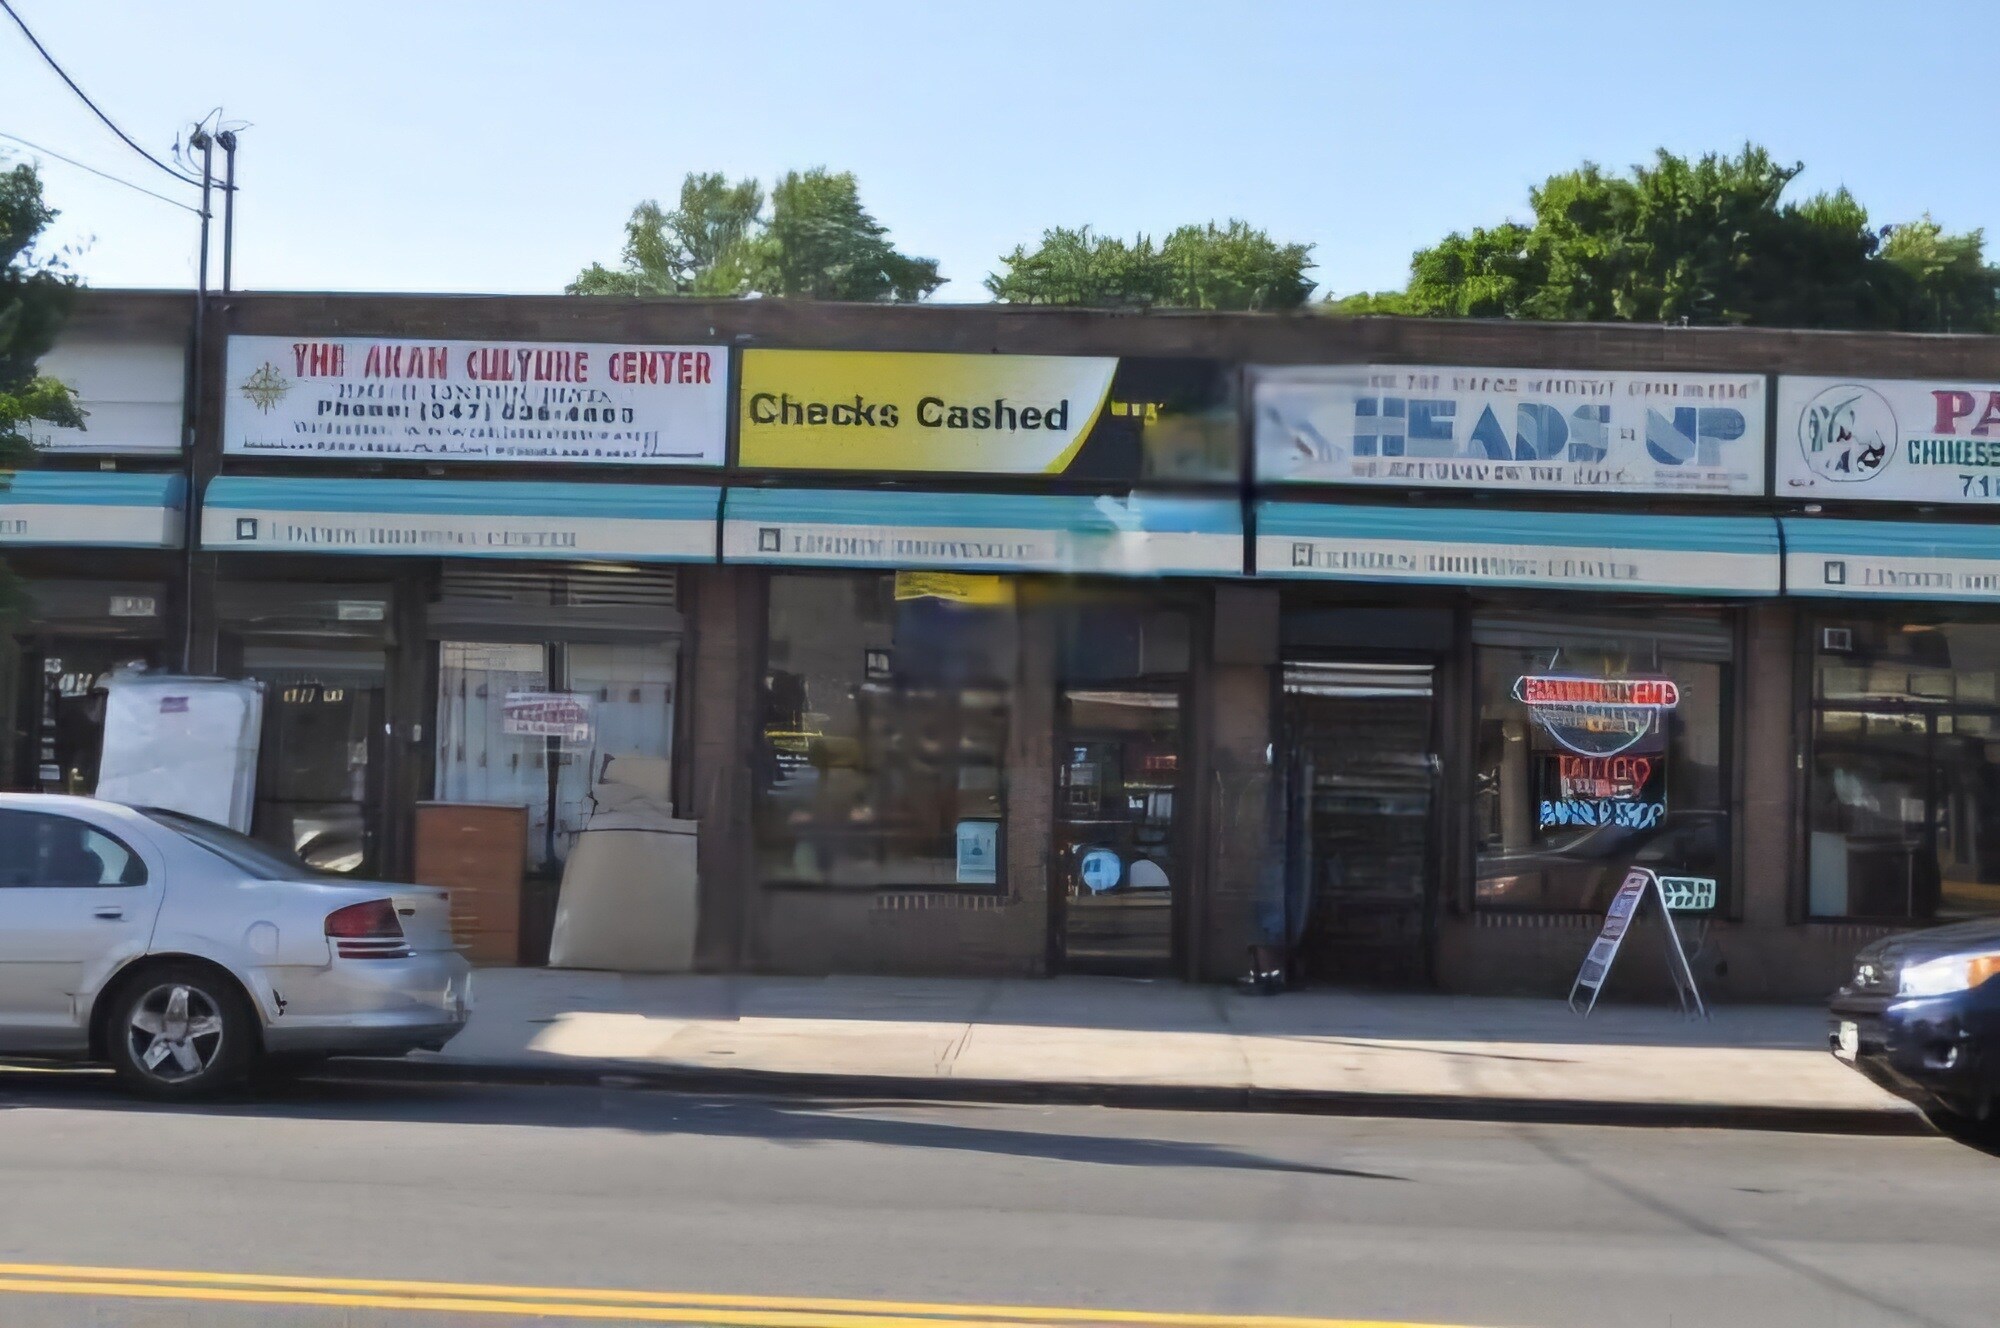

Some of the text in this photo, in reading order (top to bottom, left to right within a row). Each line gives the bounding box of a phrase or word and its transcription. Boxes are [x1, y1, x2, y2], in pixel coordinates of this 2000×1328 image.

[608, 350, 712, 384] CENTER
[748, 392, 899, 428] Checks
[916, 396, 1069, 431] Cashed
